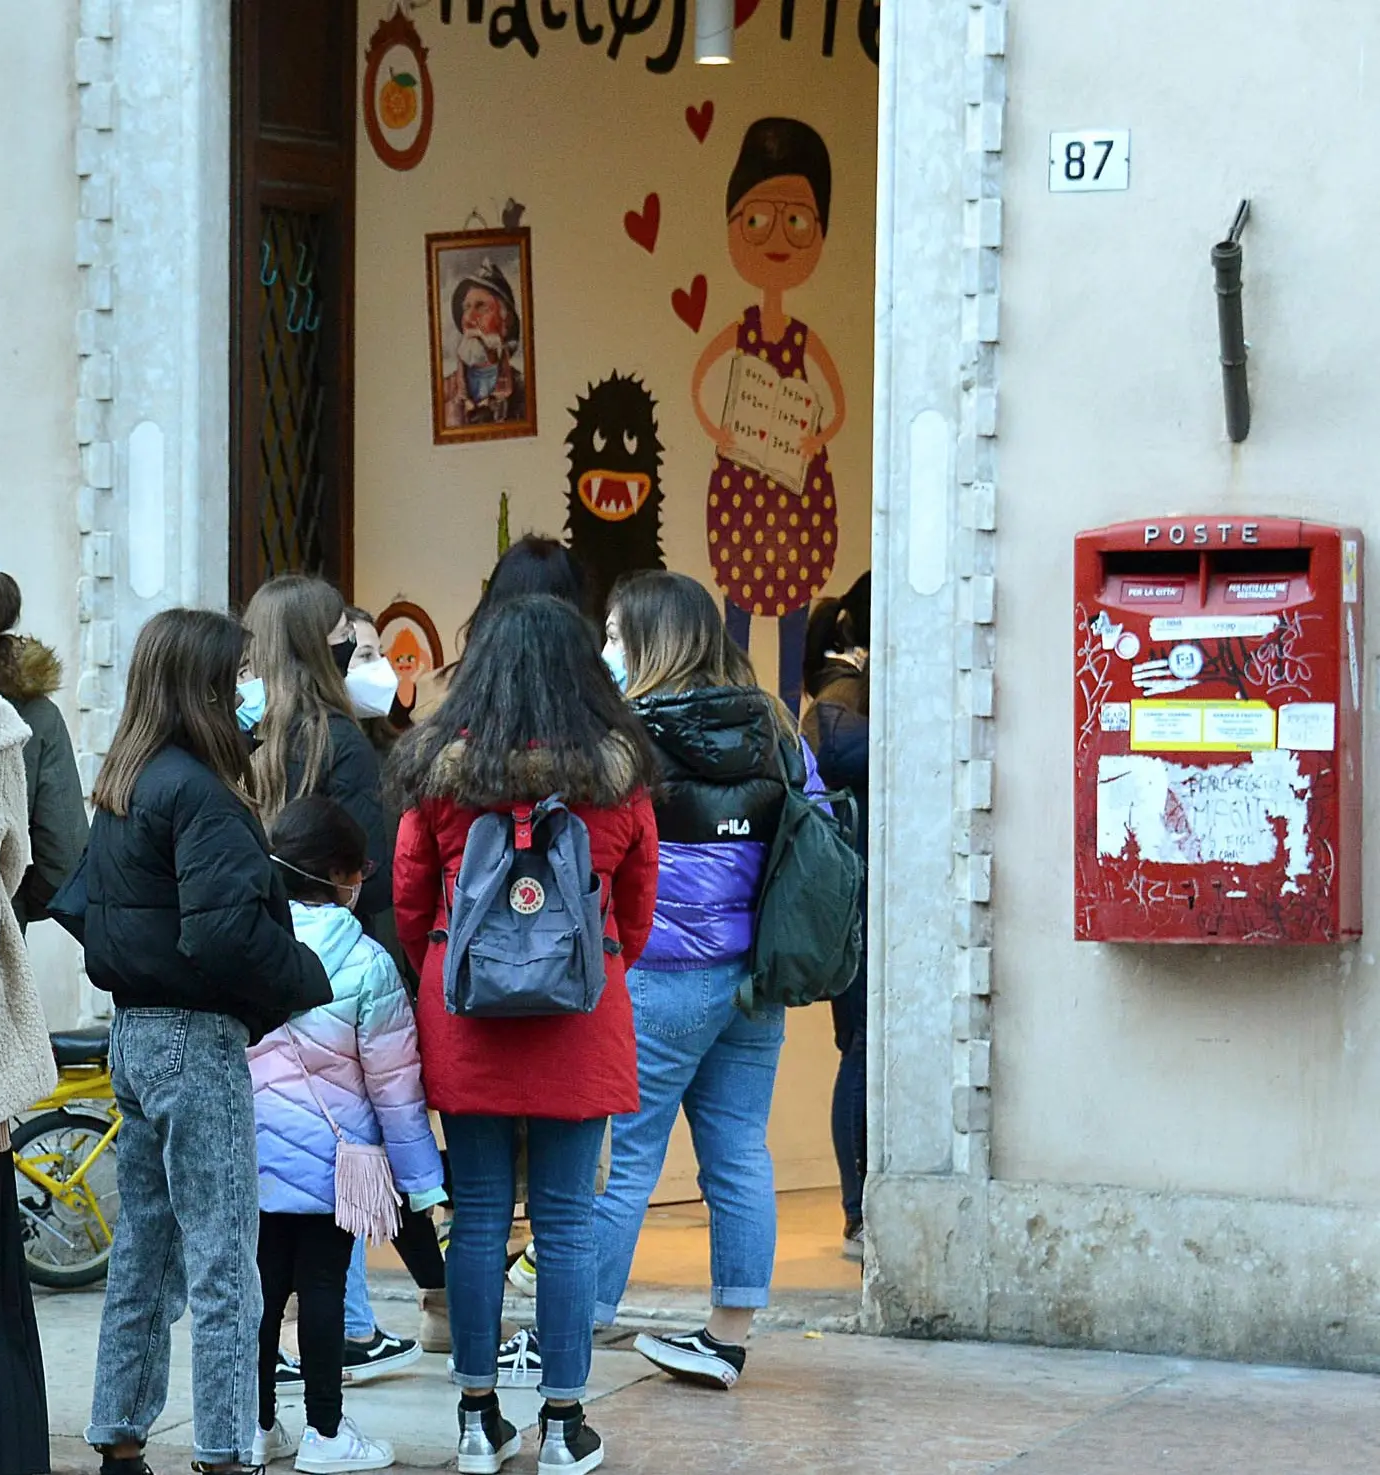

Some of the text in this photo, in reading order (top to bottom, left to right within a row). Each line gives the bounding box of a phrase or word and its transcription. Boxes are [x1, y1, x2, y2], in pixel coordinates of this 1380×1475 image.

[1065, 140, 1113, 180] 87
[1144, 523, 1259, 544] POSTE
[1128, 588, 1143, 597] PER
[1144, 588, 1154, 597] LA
[1228, 583, 1242, 592] PER
[717, 819, 750, 835] FILA
